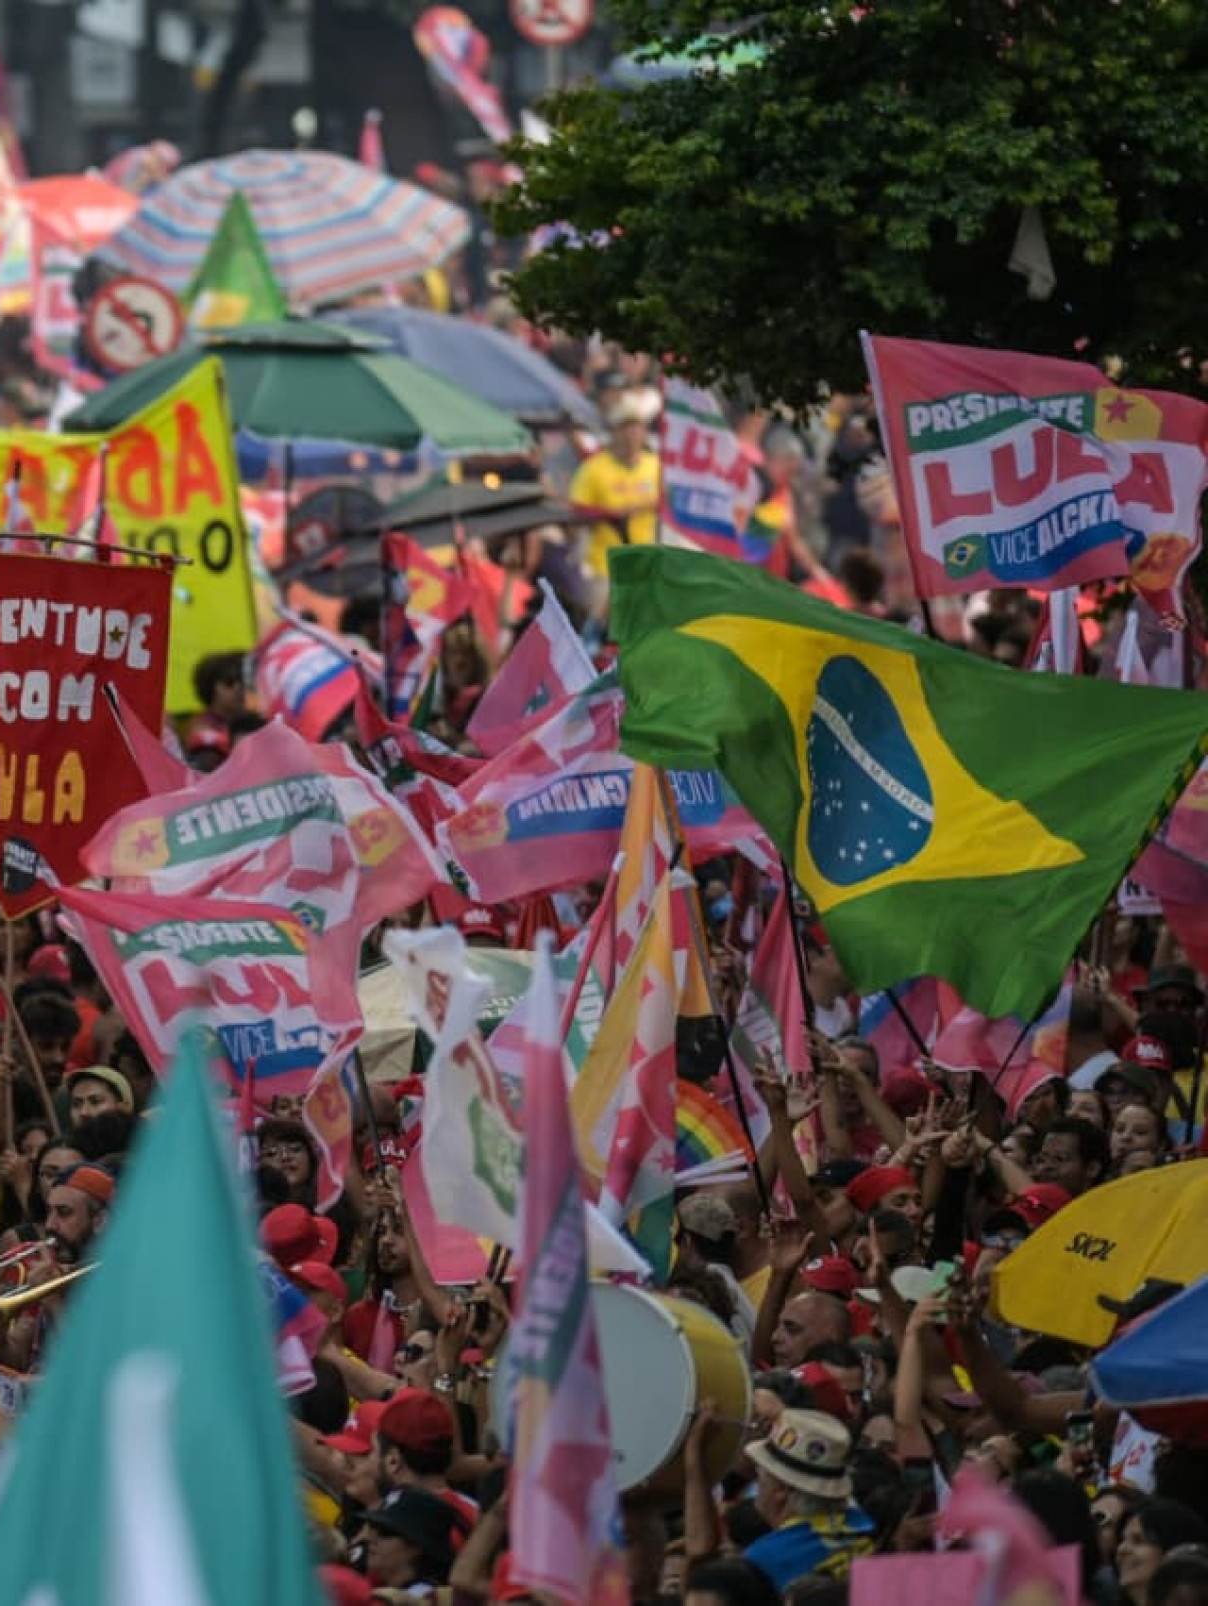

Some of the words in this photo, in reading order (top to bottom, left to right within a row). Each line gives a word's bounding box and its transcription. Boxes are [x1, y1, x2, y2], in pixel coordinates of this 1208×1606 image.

[923, 426, 1175, 528] LULA
[991, 530, 1039, 565] VICE
[139, 958, 313, 1025] LUL
[222, 1023, 274, 1063] VICE
